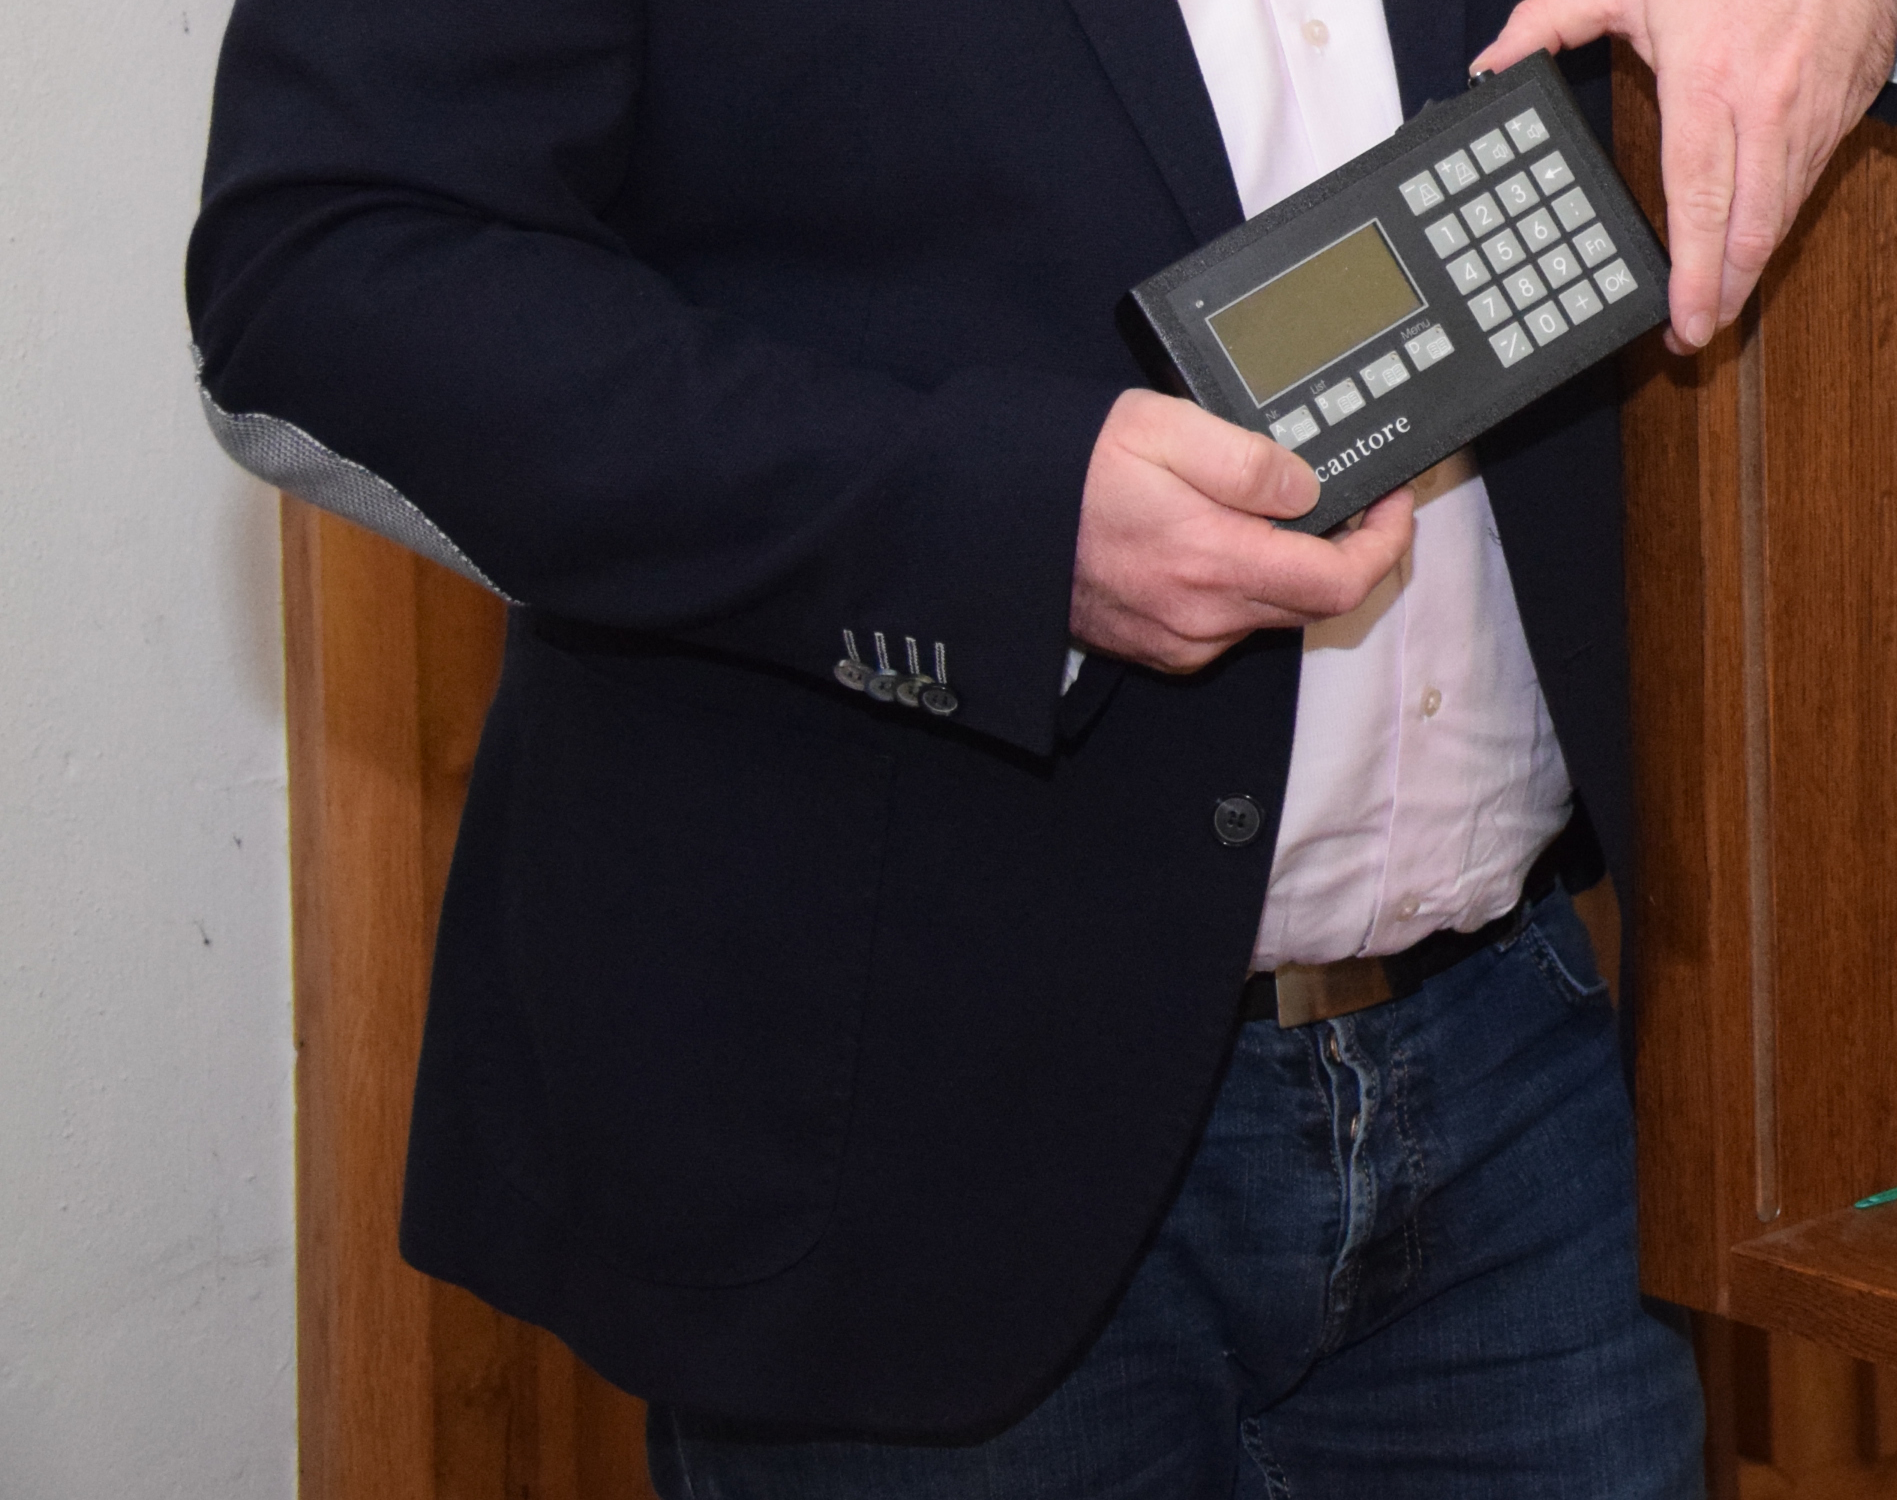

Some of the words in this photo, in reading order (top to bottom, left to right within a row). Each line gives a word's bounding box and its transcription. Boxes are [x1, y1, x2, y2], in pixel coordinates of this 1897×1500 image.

[1441, 226, 1456, 244] 1
[1475, 205, 1494, 226] 2
[1510, 184, 1527, 204] 3
[1464, 262, 1479, 281] 4
[1496, 241, 1514, 261] 5
[1533, 220, 1549, 240] 6
[1585, 237, 1608, 256] Fn
[1482, 297, 1496, 318] 7
[1517, 278, 1535, 297] 8
[1553, 256, 1567, 276] 9
[1605, 269, 1631, 293] OK
[1400, 318, 1432, 341] Menu
[1538, 313, 1557, 334] 0
[1408, 342, 1421, 355] D
[1364, 369, 1376, 381] C
[1309, 379, 1328, 396] List
[1318, 397, 1329, 410] B
[1275, 424, 1287, 437] A
[1314, 415, 1412, 483] cantore
